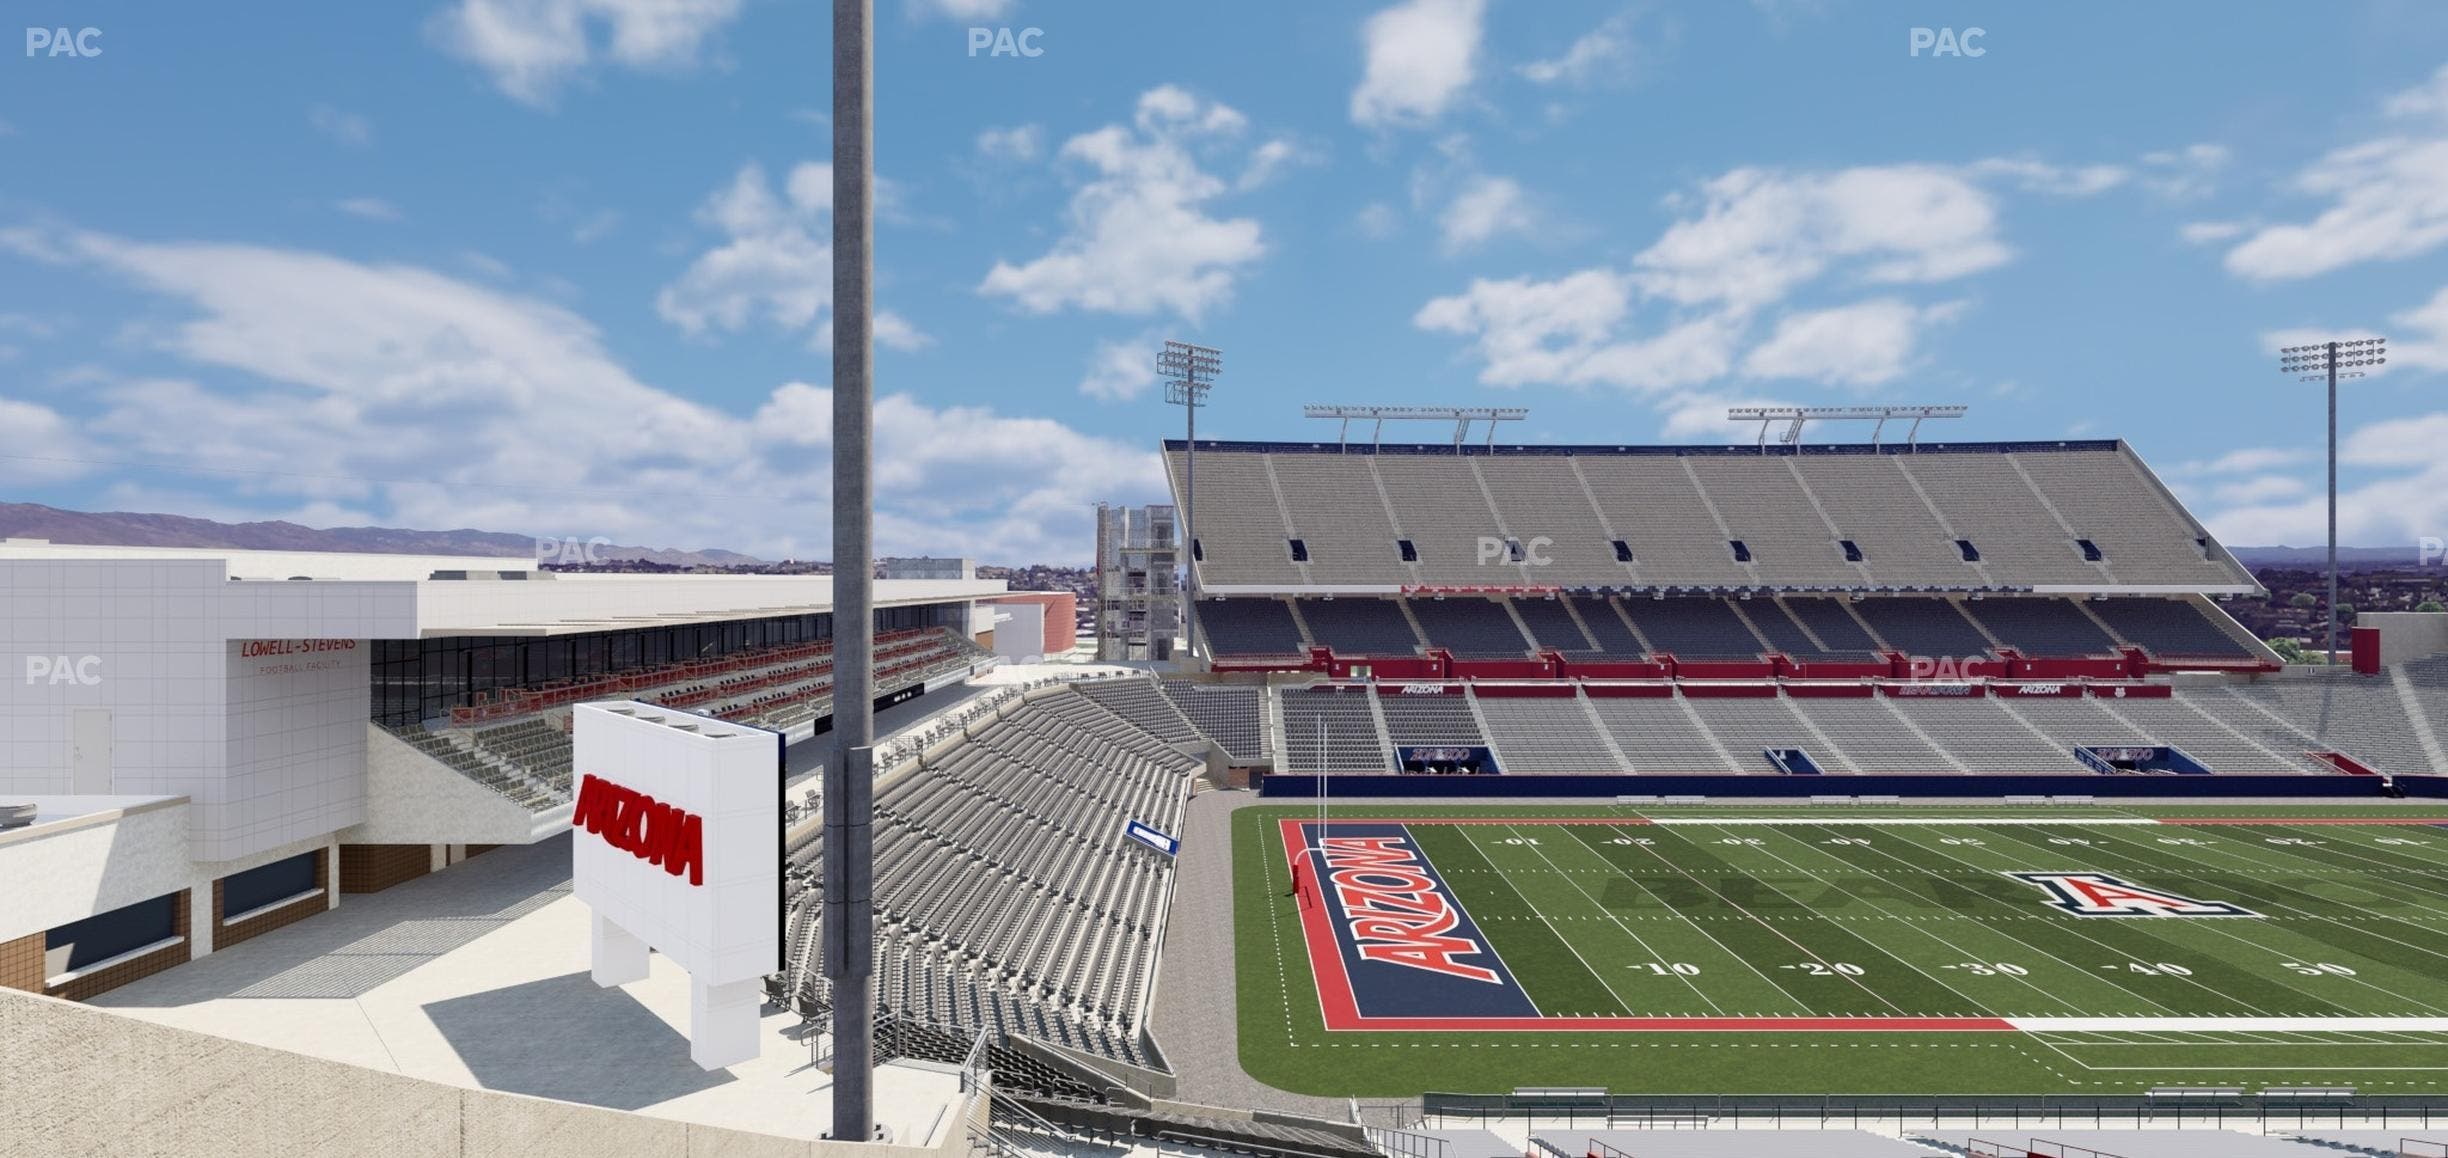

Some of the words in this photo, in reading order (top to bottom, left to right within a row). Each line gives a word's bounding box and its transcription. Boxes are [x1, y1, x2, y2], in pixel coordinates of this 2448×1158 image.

[241, 639, 356, 658] LOWELL-STEVENS
[1401, 684, 1443, 694] ARIZONA
[2019, 685, 2061, 694] ARIZONA
[1318, 836, 1504, 985] ARIZONA
[1642, 962, 1701, 976] 10
[1799, 962, 1865, 976] 20
[1960, 962, 2029, 976] 30
[2128, 962, 2193, 976] 40
[2280, 962, 2357, 976] 50
